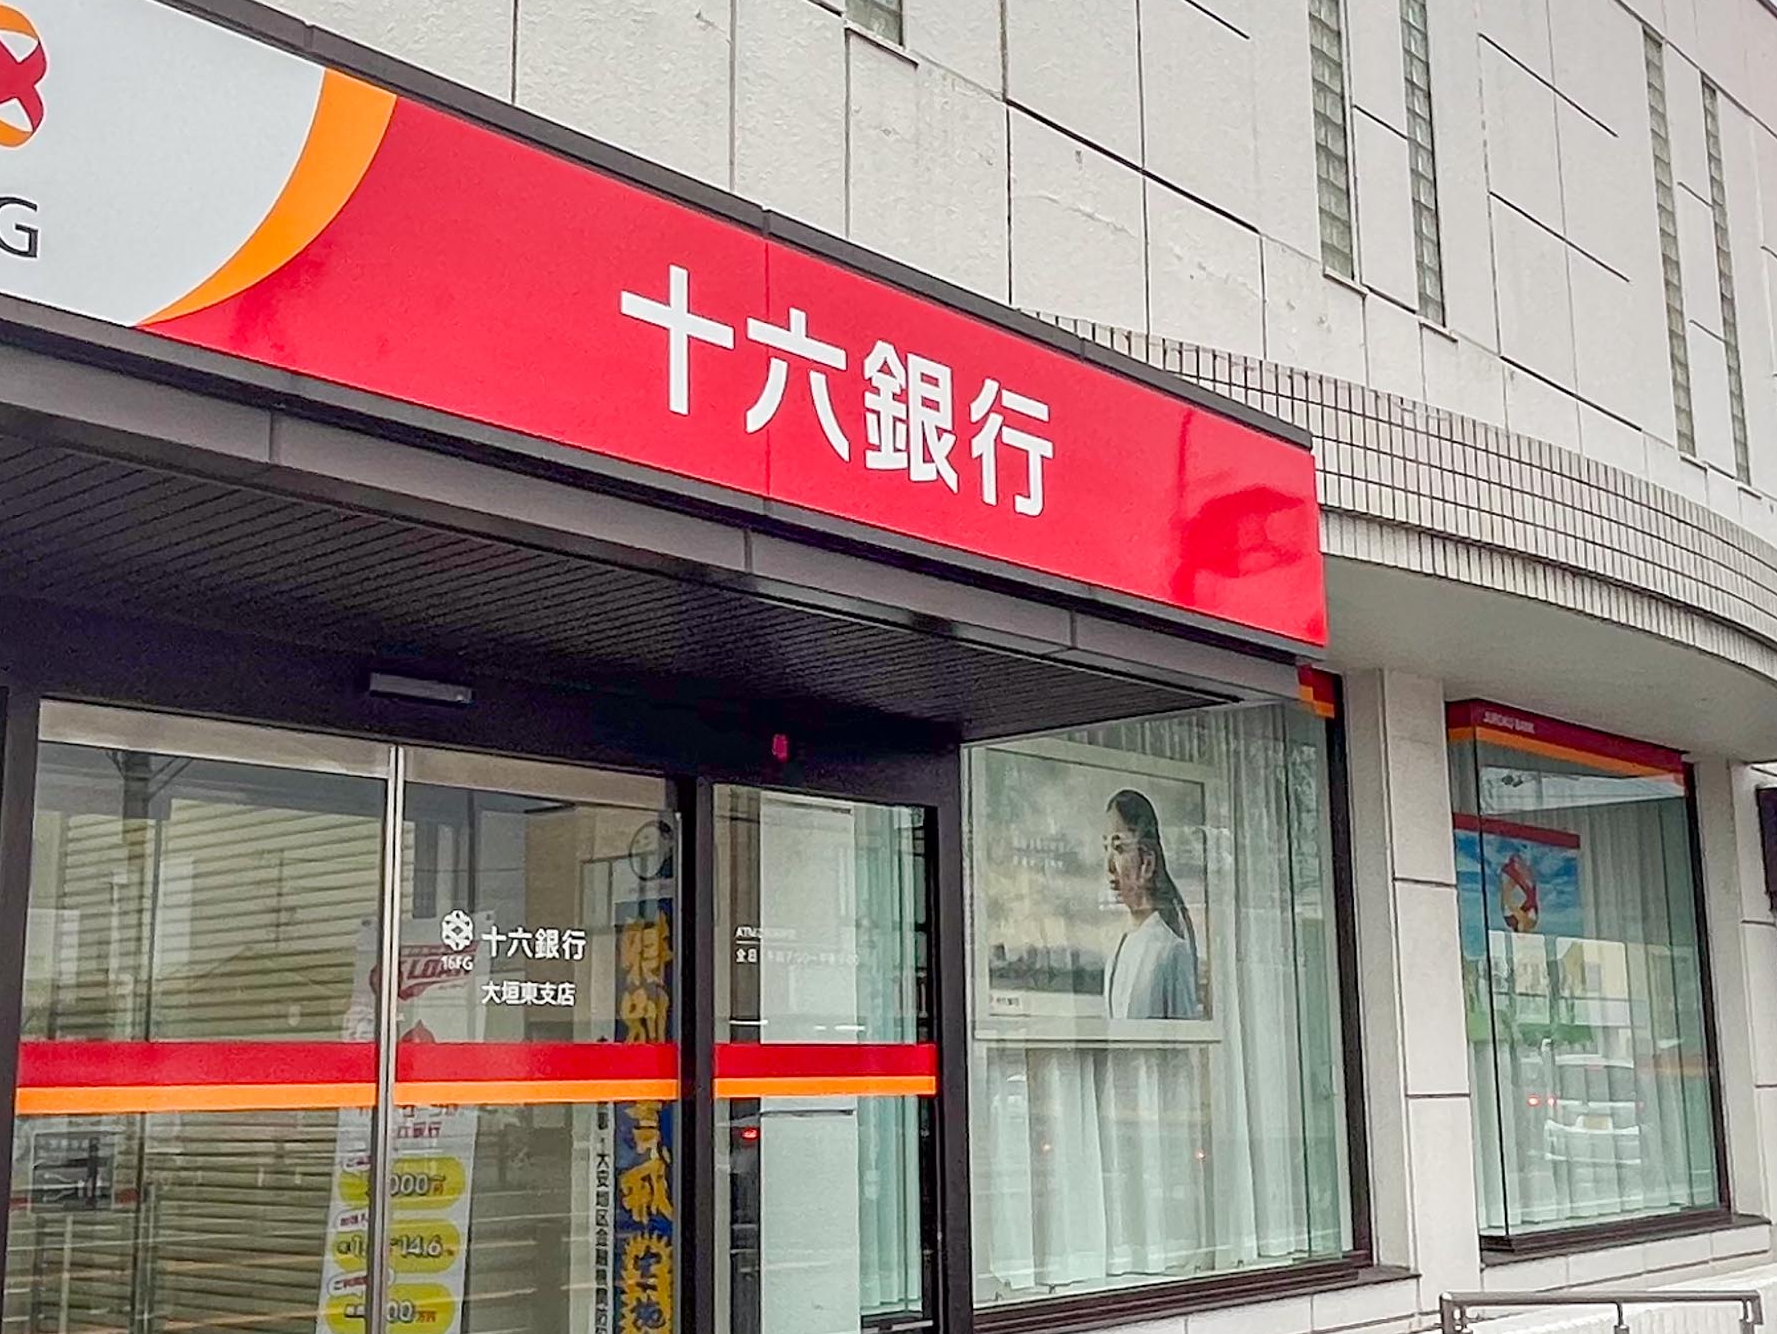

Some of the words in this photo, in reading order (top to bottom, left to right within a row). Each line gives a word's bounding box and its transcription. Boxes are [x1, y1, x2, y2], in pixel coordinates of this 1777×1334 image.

[619, 263, 1055, 518] 十六銀行
[481, 924, 587, 961] 十六銀行
[440, 955, 474, 972] 16FG
[481, 980, 577, 1007] 大垣東支店
